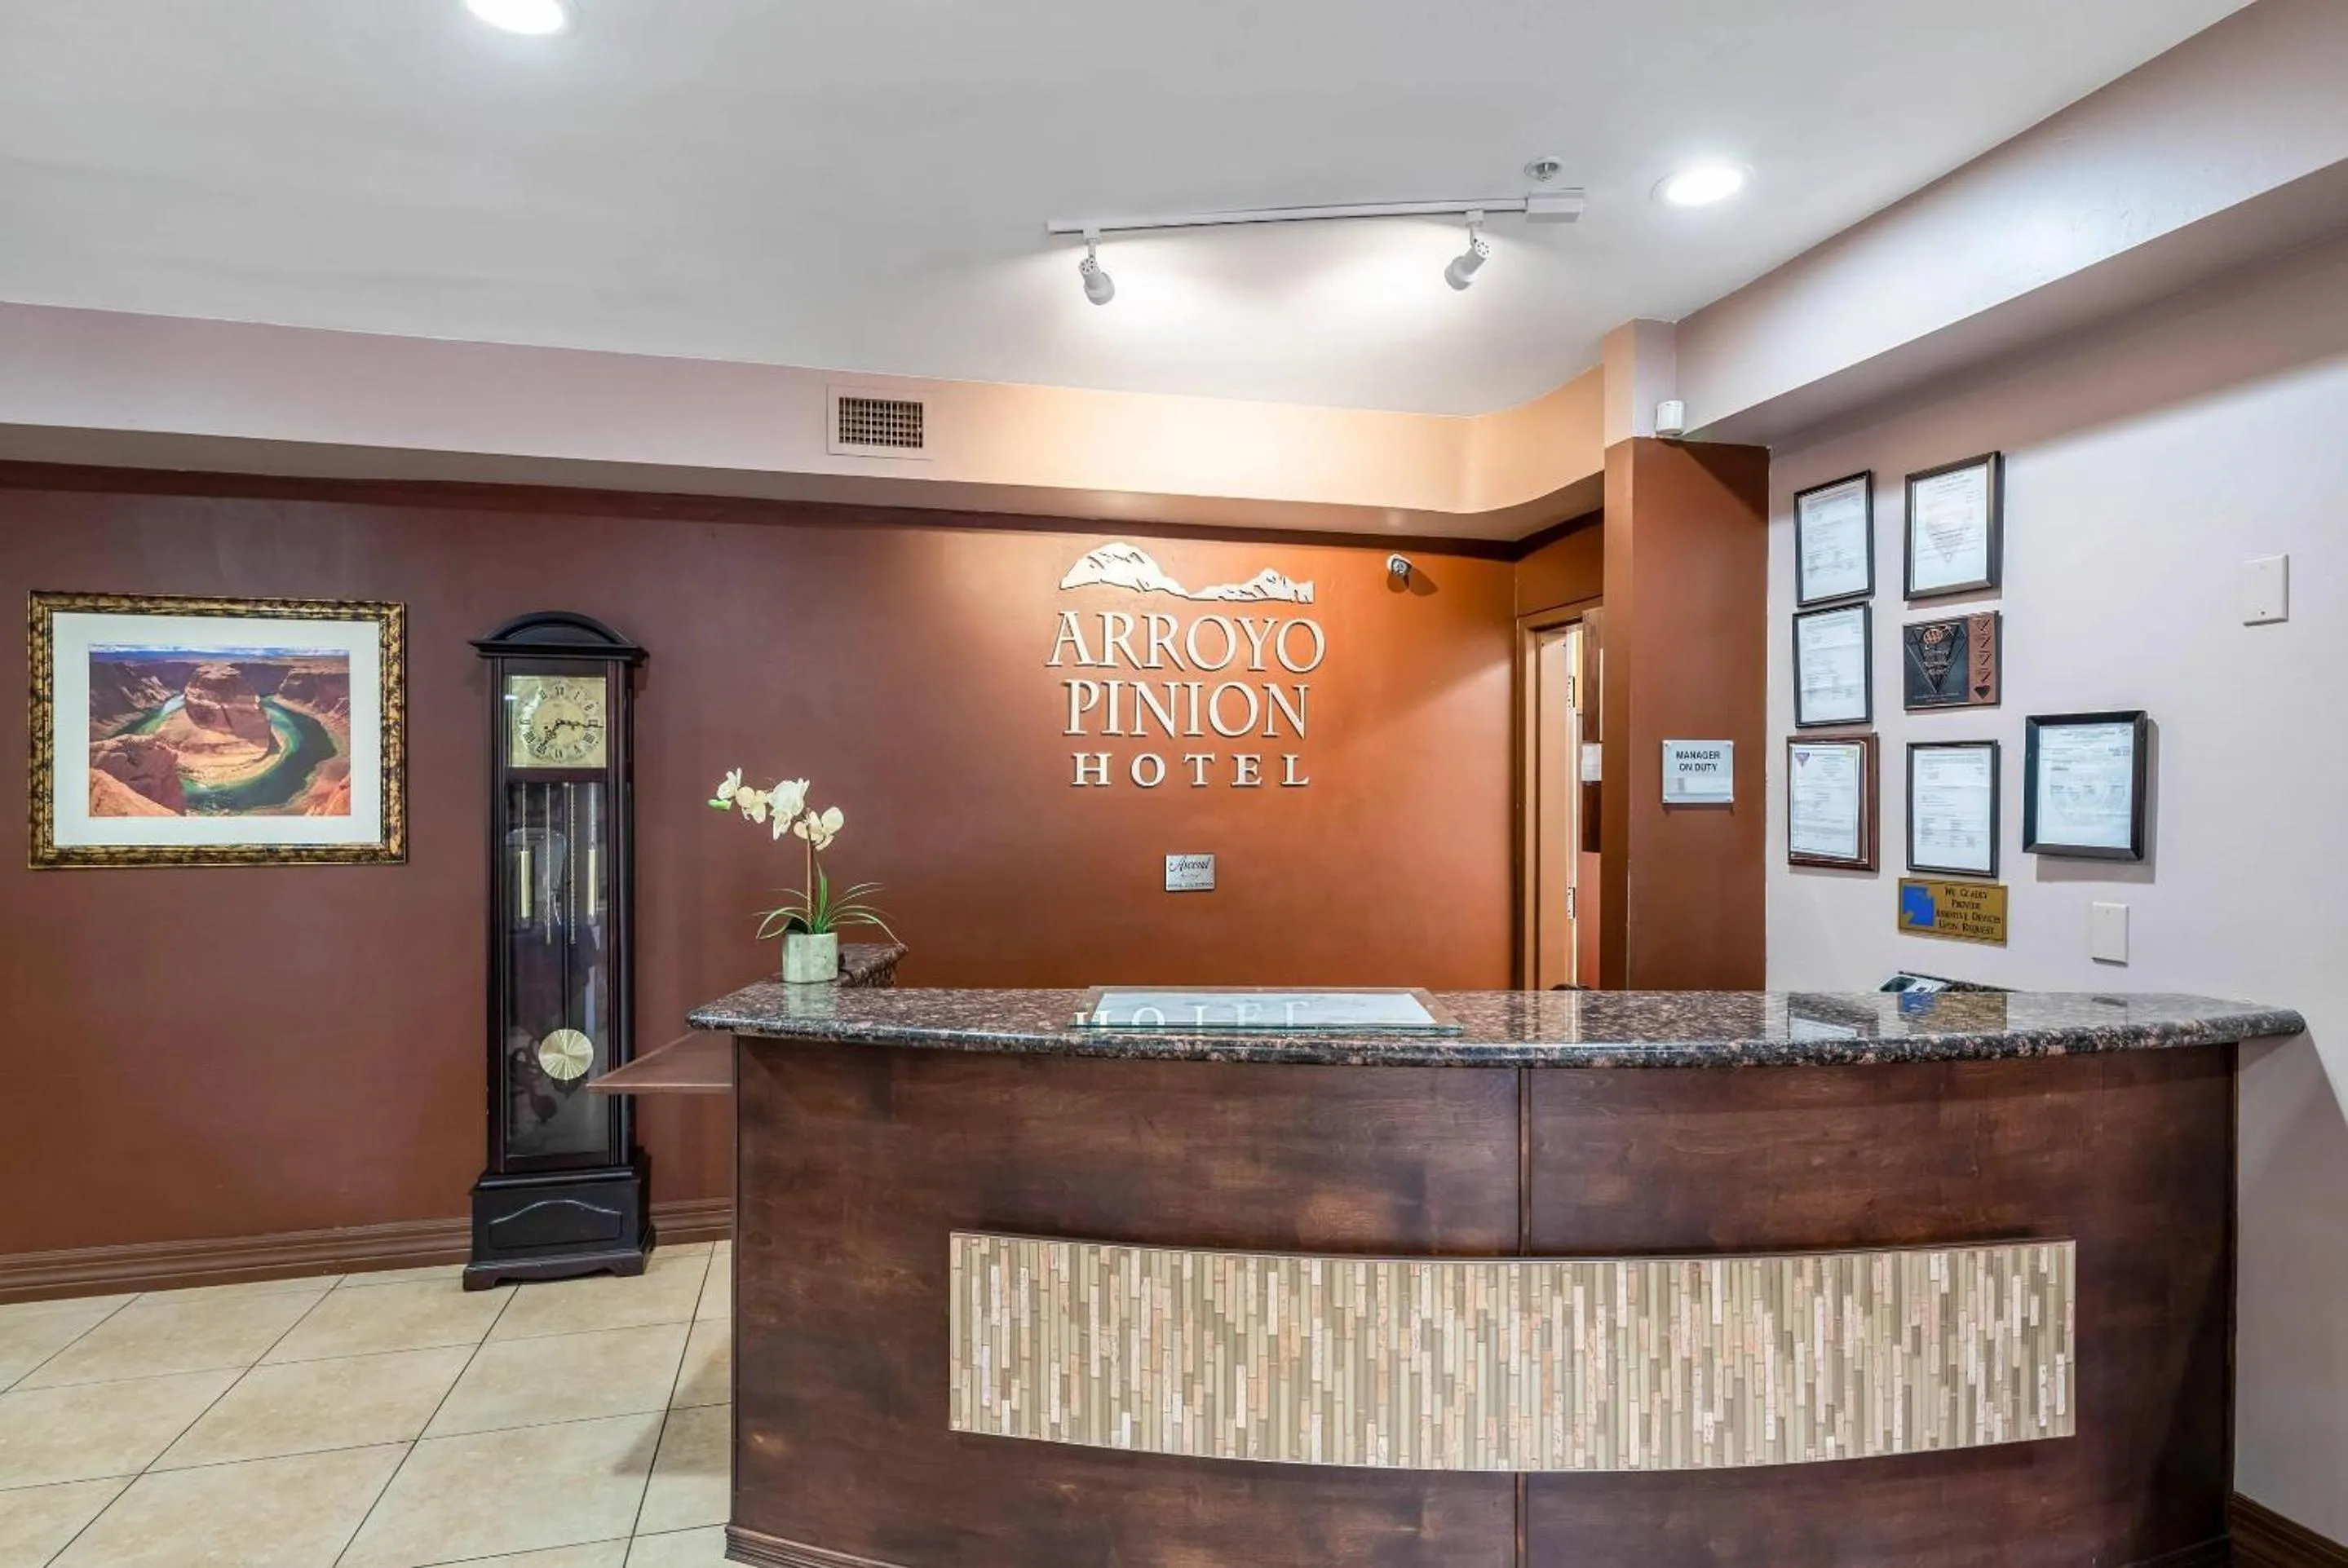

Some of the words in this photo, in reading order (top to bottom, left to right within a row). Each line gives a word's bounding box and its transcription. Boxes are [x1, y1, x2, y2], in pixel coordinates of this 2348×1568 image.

[1046, 611, 1325, 673] ARROYO
[1063, 678, 1309, 739] PINION
[1071, 753, 1309, 787] HOTEL
[1676, 751, 1720, 759] MANAGER
[1679, 763, 1692, 771] ON
[1695, 763, 1718, 771] DUTY
